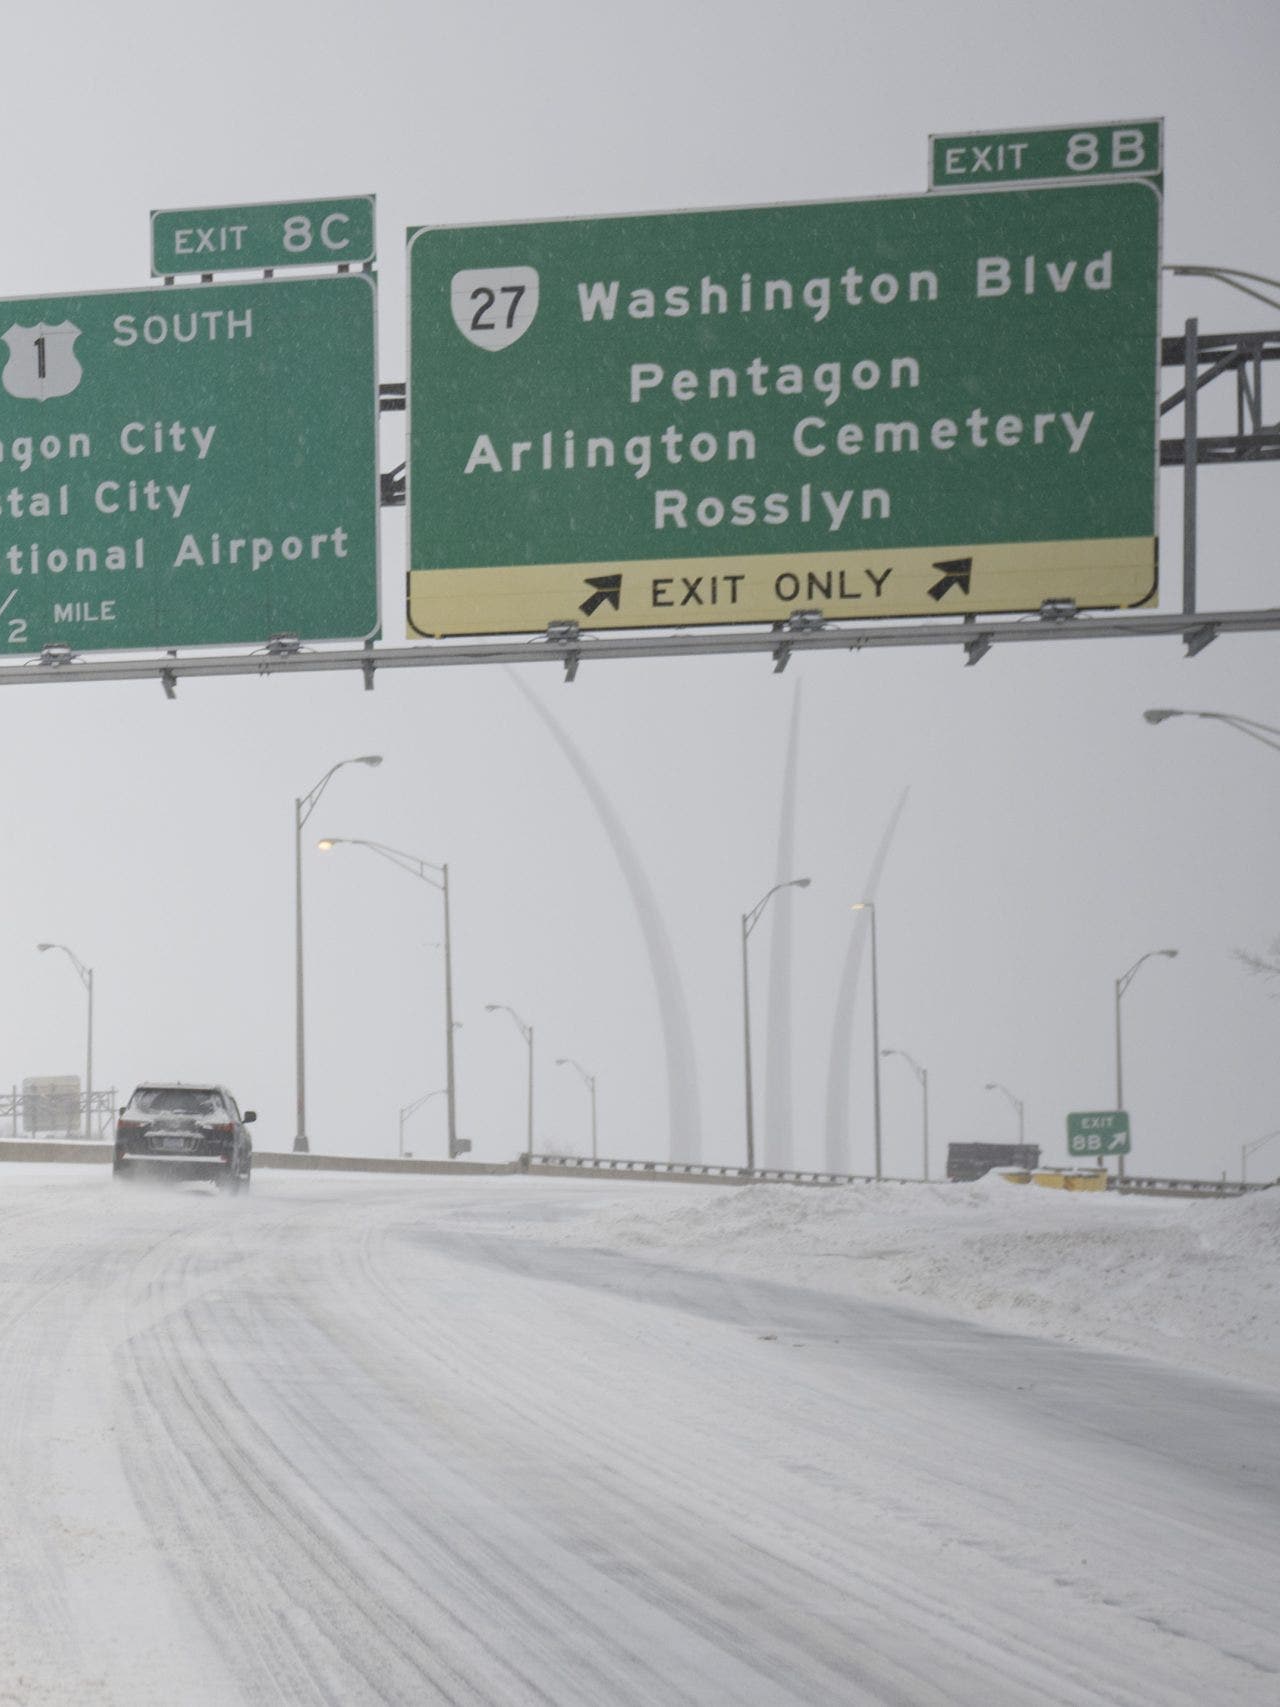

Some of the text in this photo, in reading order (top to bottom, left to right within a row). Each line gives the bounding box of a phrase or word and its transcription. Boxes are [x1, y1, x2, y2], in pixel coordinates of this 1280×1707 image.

[945, 131, 1148, 174] EXIT 8B
[175, 213, 351, 255] EXIT 8C
[469, 284, 526, 331] 27
[578, 251, 1113, 323] Washington Blvd
[112, 309, 253, 347] SOUTH
[33, 337, 46, 379] 1
[631, 356, 920, 406] Pentagon
[121, 422, 217, 459] City
[464, 410, 1095, 480] Arlington Cemetery
[94, 481, 191, 516] City
[654, 484, 891, 531] Rosslyn
[174, 526, 349, 572] Airport
[651, 568, 894, 608] EXIT ONLY
[54, 600, 117, 624] MILE
[1073, 1136, 1102, 1150] 8B
[1083, 1117, 1114, 1129] EXIT
